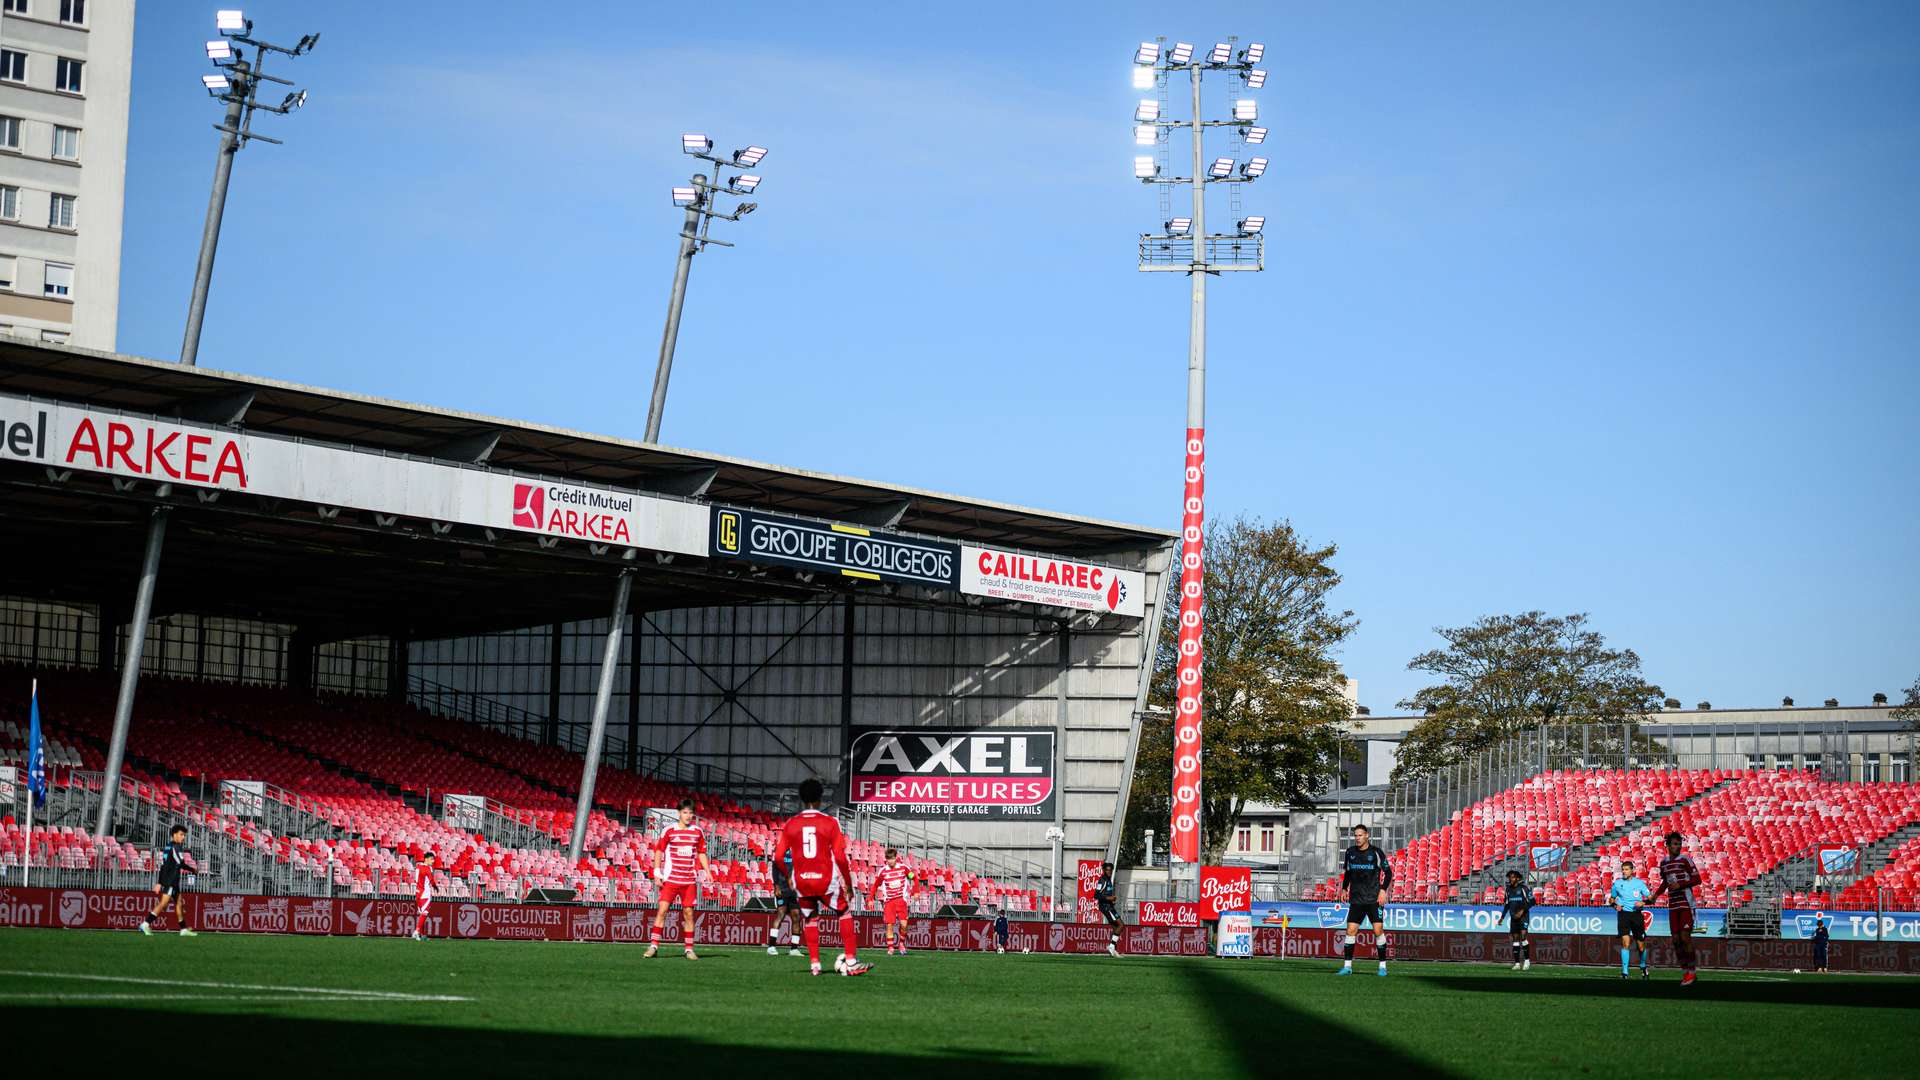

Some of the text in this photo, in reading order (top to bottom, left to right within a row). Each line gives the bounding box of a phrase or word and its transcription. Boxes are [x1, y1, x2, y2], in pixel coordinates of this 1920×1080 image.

[66, 417, 247, 488] ARKEA
[549, 487, 632, 512] Crédit Mutuel
[548, 508, 630, 543] ARKEA
[750, 524, 952, 579] GROUPE LOBLIGEOIS
[978, 551, 1103, 591] CAILLAREC
[980, 576, 1000, 588] chaud
[1001, 580, 1007, 588] &
[1008, 580, 1024, 591] froid
[1034, 584, 1057, 595] cuisine
[1057, 588, 1102, 601] professionnelle
[987, 589, 1004, 597] BREST
[1042, 597, 1063, 605] LORIENT
[860, 736, 1043, 773] AXEL
[859, 780, 1041, 800] FERMETURES
[856, 803, 1041, 815] FENETRES PORTES DE GARAGE PORTAILS
[802, 826, 817, 859] 5
[1201, 875, 1249, 899] Breizh
[377, 902, 415, 914] FONDS
[1078, 896, 1099, 912] Breiz
[1212, 893, 1244, 913] Cola
[107, 915, 168, 927] MATERUX
[206, 912, 241, 928] MALO
[252, 914, 286, 930] MALO
[481, 907, 561, 925] QUEGUINER
[708, 913, 740, 925] FONDS
[1142, 902, 1198, 926] Breizh Cola
[1462, 910, 1503, 930] TOP
[1507, 912, 1602, 933] antique
[296, 914, 330, 931] MALO
[377, 915, 442, 936] LE SANT
[575, 923, 604, 938] MALO
[1850, 916, 1896, 937] TOP
[497, 926, 546, 937] MATERIAUX
[614, 924, 642, 939] MALO
[708, 925, 721, 943] LE
[874, 932, 899, 946] MAO
[905, 933, 930, 946] MALO
[1066, 927, 1123, 941] QUEGUIN
[1356, 933, 1434, 946] QUGUINER
[937, 934, 961, 947] MALO
[1132, 939, 1153, 951] MALO
[1160, 940, 1179, 953] MALO
[1185, 941, 1205, 953] MALO
[1262, 938, 1277, 955] LE
[1223, 944, 1250, 955] MALO
[1371, 947, 1420, 957] MTERIAUX
[1451, 945, 1484, 959] MALO
[1537, 948, 1571, 961] MALO
[1751, 942, 1842, 957] QUEGUIR
